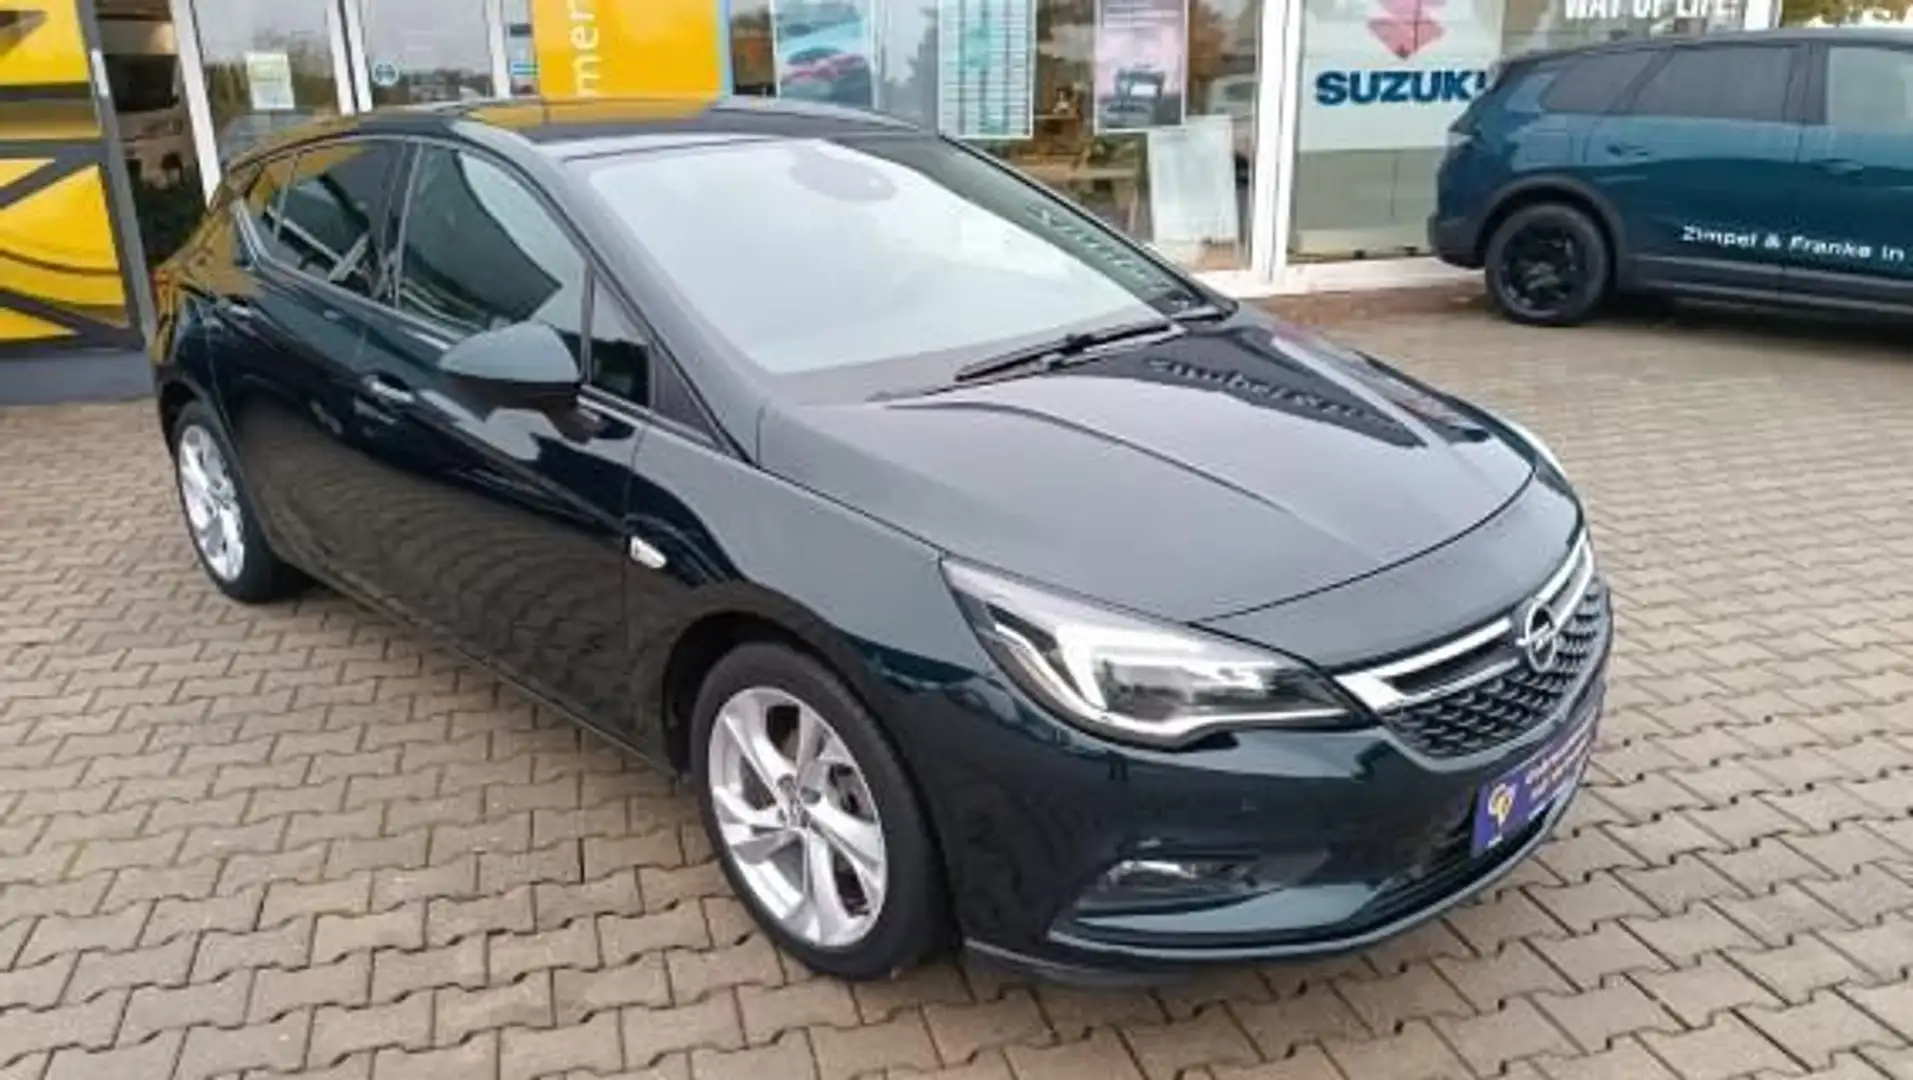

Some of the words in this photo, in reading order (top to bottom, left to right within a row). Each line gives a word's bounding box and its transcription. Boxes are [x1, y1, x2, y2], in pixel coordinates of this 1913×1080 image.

[1682, 225, 1758, 248] Zimpel
[1764, 233, 1781, 248] &
[1789, 235, 1872, 259] Franke
